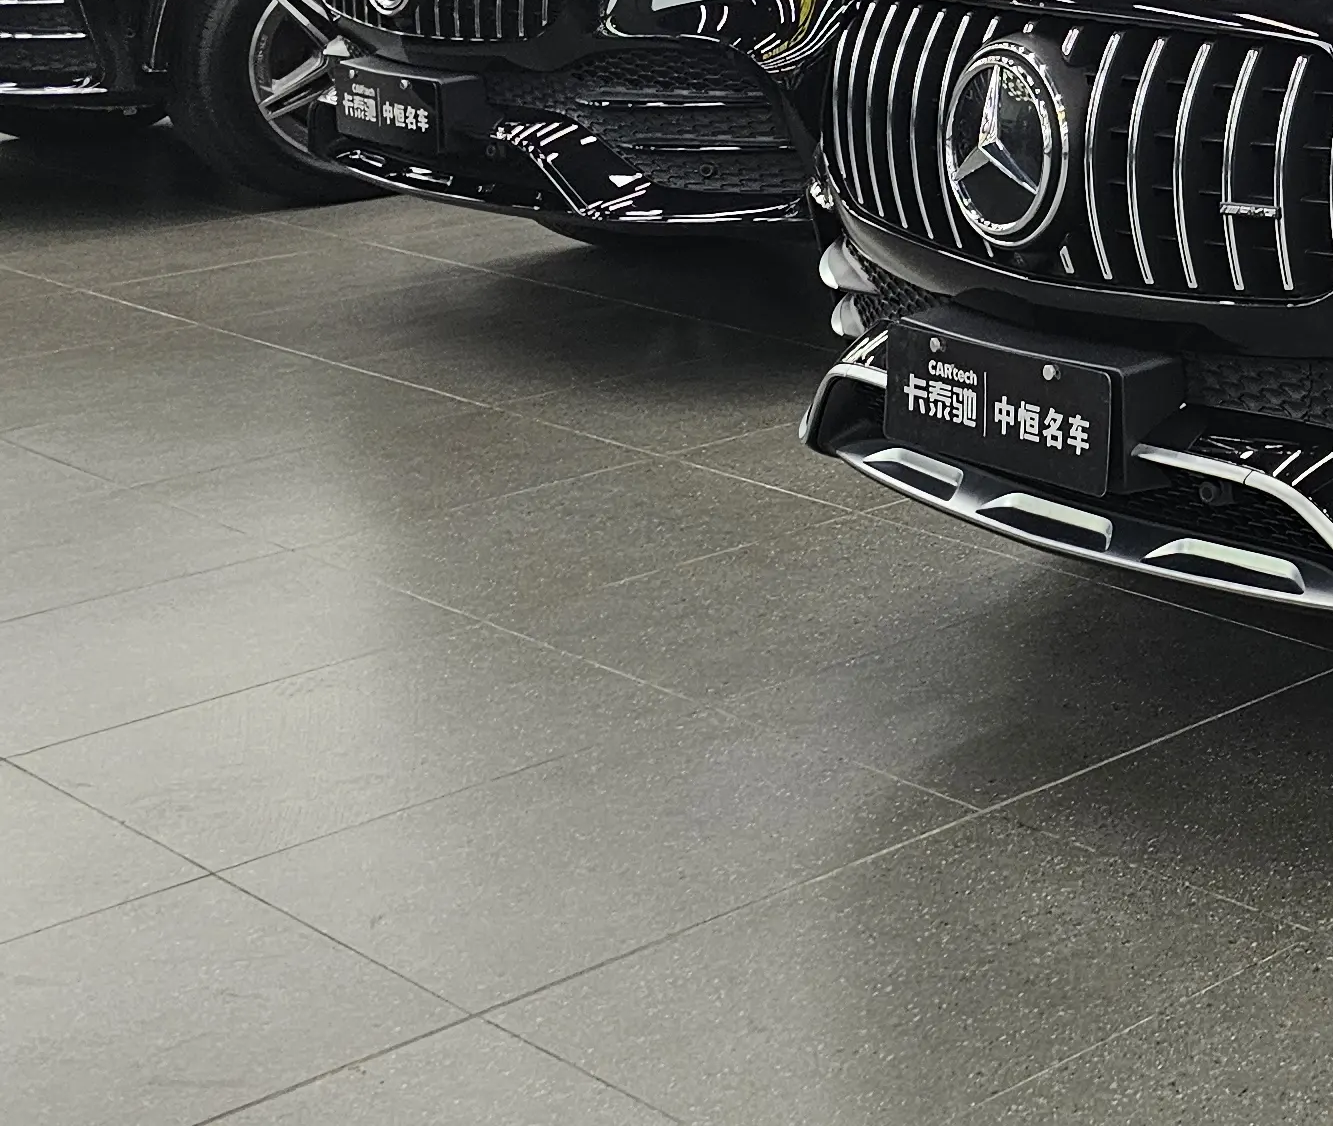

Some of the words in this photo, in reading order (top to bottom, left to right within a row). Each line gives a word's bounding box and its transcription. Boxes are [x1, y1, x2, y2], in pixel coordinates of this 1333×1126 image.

[382, 101, 429, 132] 中恒名车
[928, 360, 978, 386] CARtech
[903, 373, 977, 428] 卡泰驰
[994, 395, 1090, 456] 中恒名车
